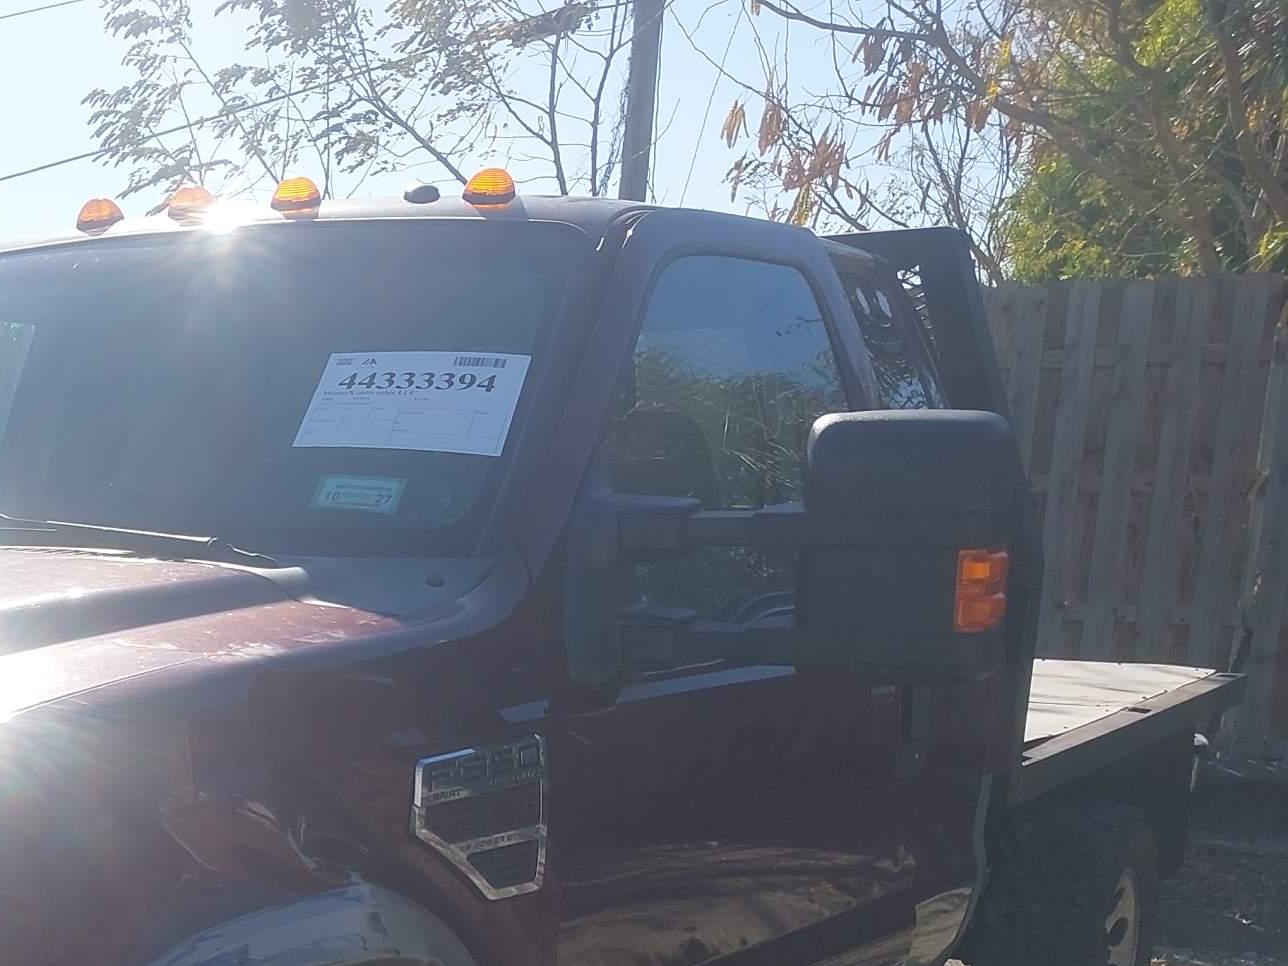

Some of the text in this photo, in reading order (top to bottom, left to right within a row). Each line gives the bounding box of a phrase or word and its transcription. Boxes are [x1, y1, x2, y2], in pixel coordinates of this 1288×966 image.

[337, 371, 498, 393] 44333394
[325, 491, 393, 504] 10 27
